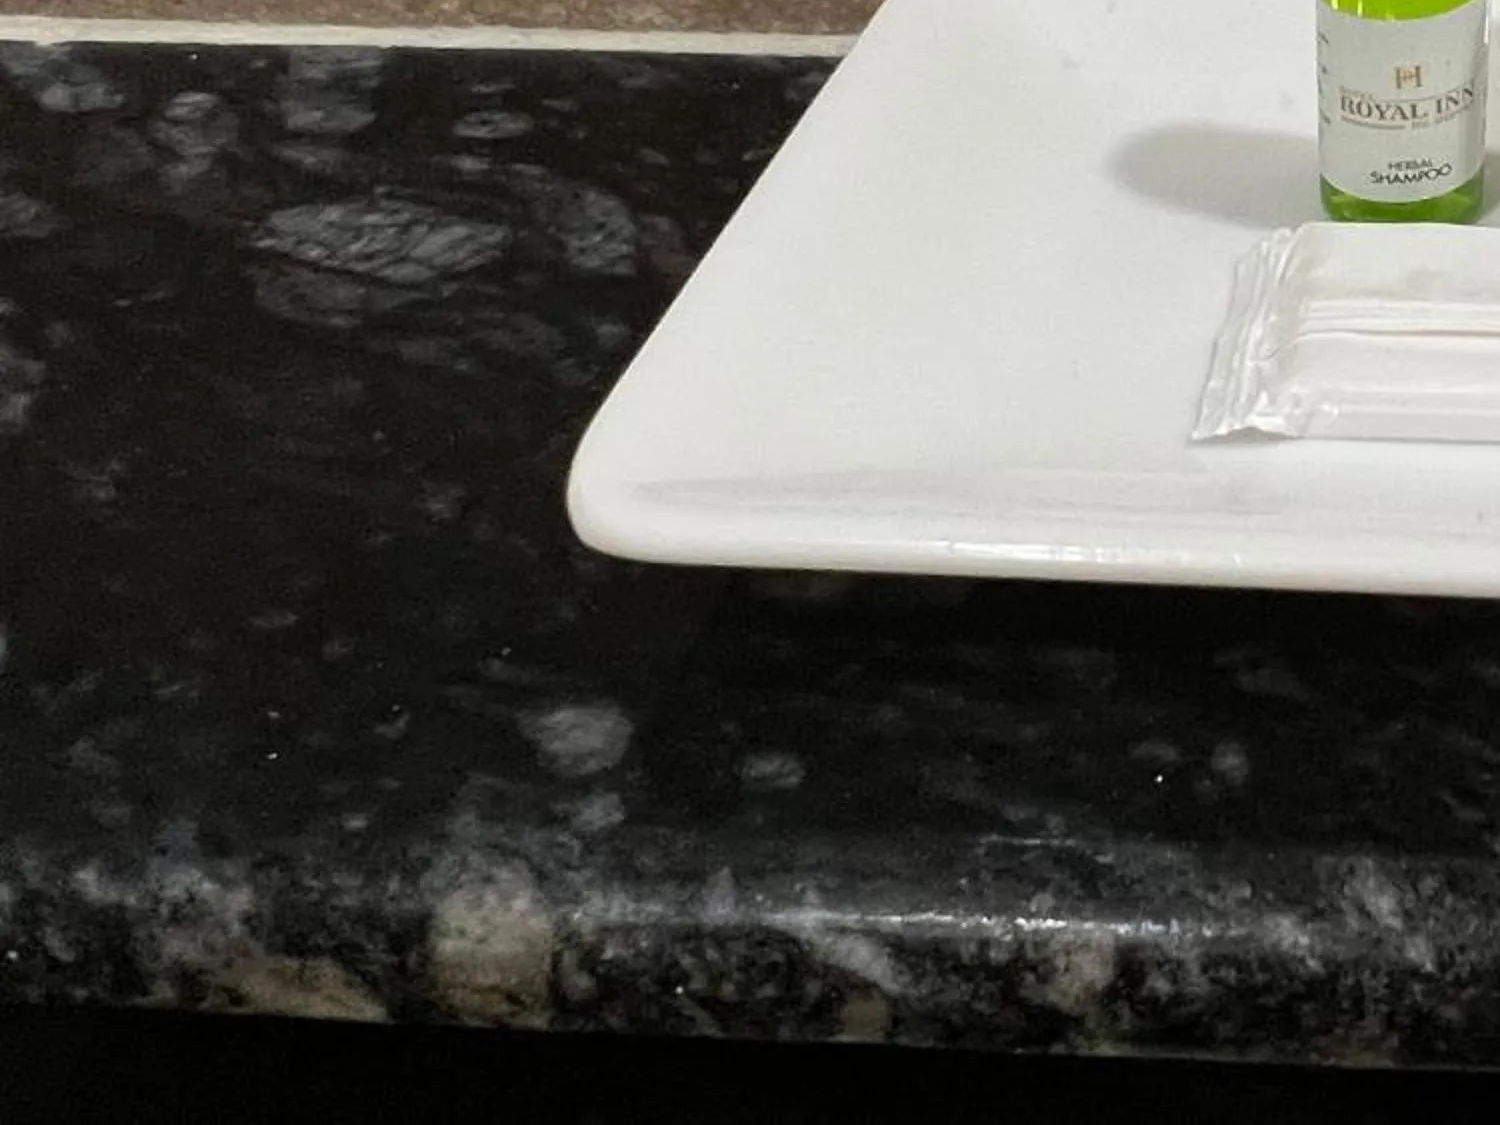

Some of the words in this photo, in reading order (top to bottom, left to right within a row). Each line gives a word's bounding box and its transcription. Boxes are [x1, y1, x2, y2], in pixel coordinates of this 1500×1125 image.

[1340, 92, 1429, 121] ROYAL
[1435, 86, 1475, 114] INN
[1370, 163, 1452, 185] SHAMPOO
[1388, 158, 1434, 171] HERBAL
